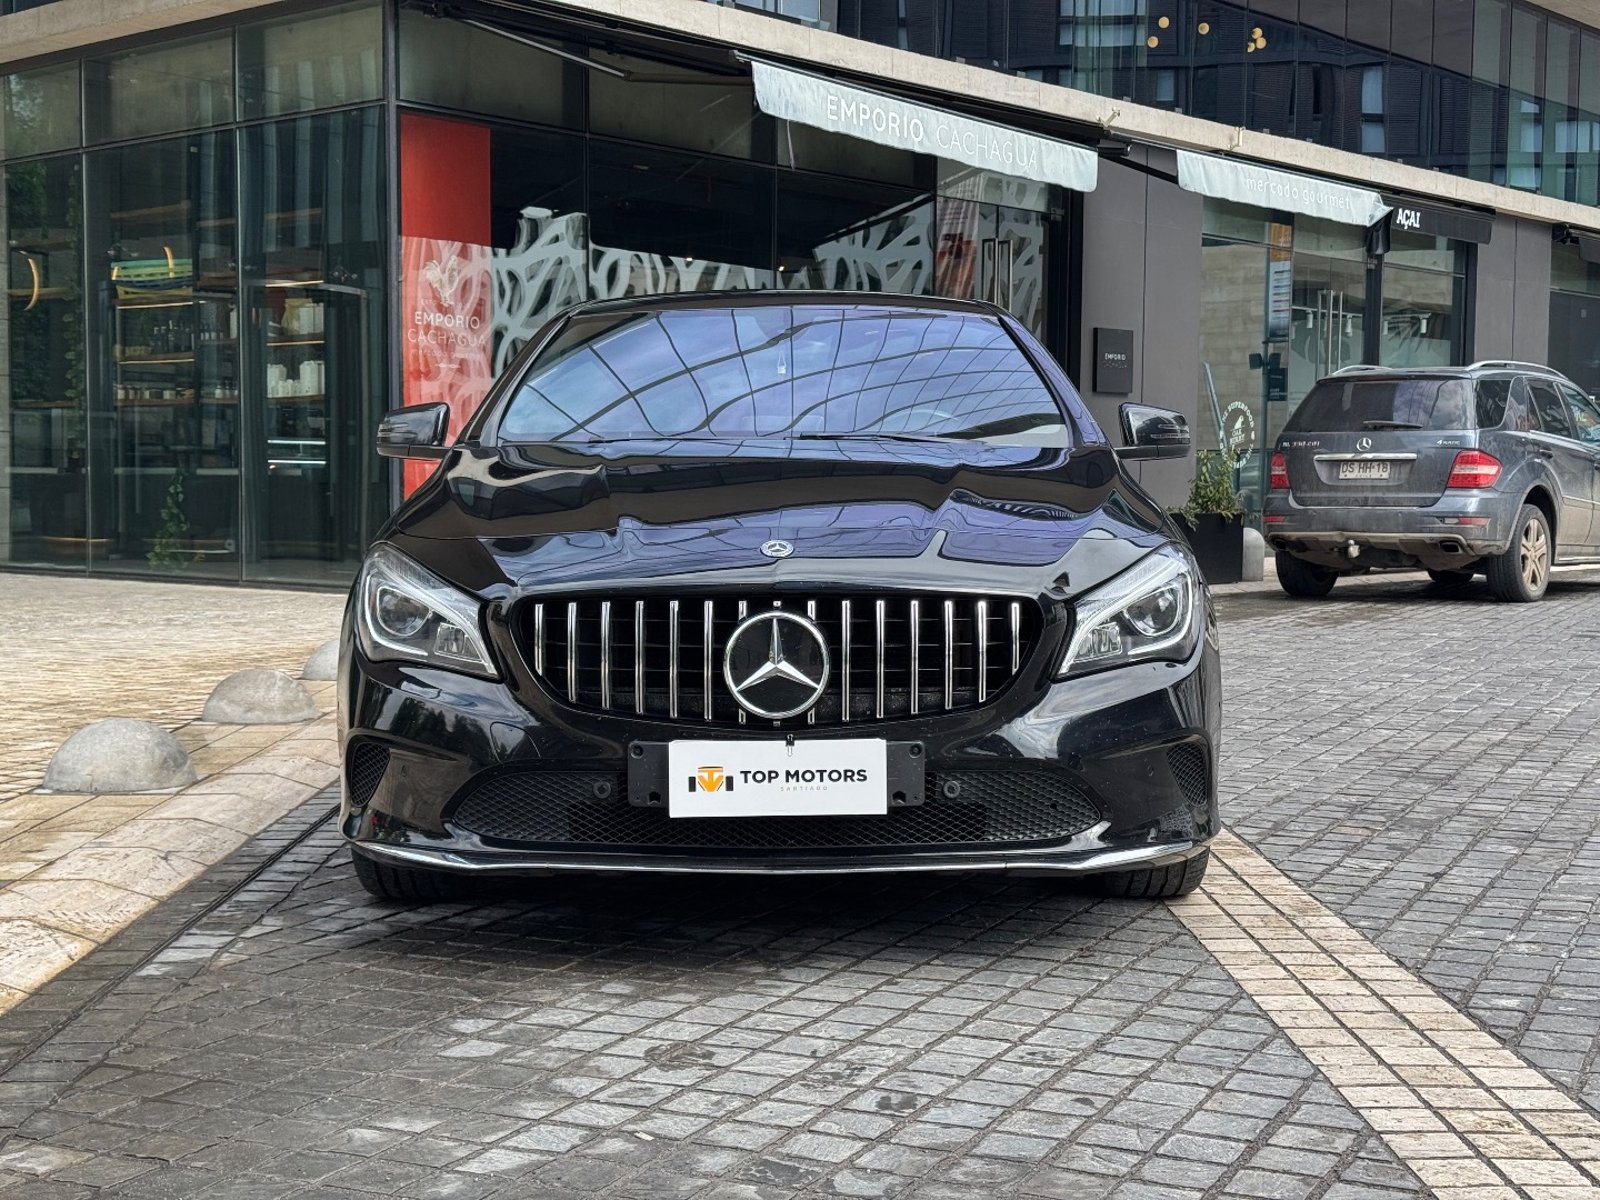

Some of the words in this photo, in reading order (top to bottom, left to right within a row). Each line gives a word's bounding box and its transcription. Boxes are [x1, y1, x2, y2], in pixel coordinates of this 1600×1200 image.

[827, 94, 924, 142] EMPORIO
[936, 125, 1038, 170] CACHAGUA
[1247, 176, 1299, 200] mercado
[1303, 190, 1352, 210] gourmet
[414, 311, 480, 330] EMPORIO
[407, 328, 486, 347] CACHAGUA
[740, 770, 779, 784] TOP
[785, 769, 868, 783] MOTORS
